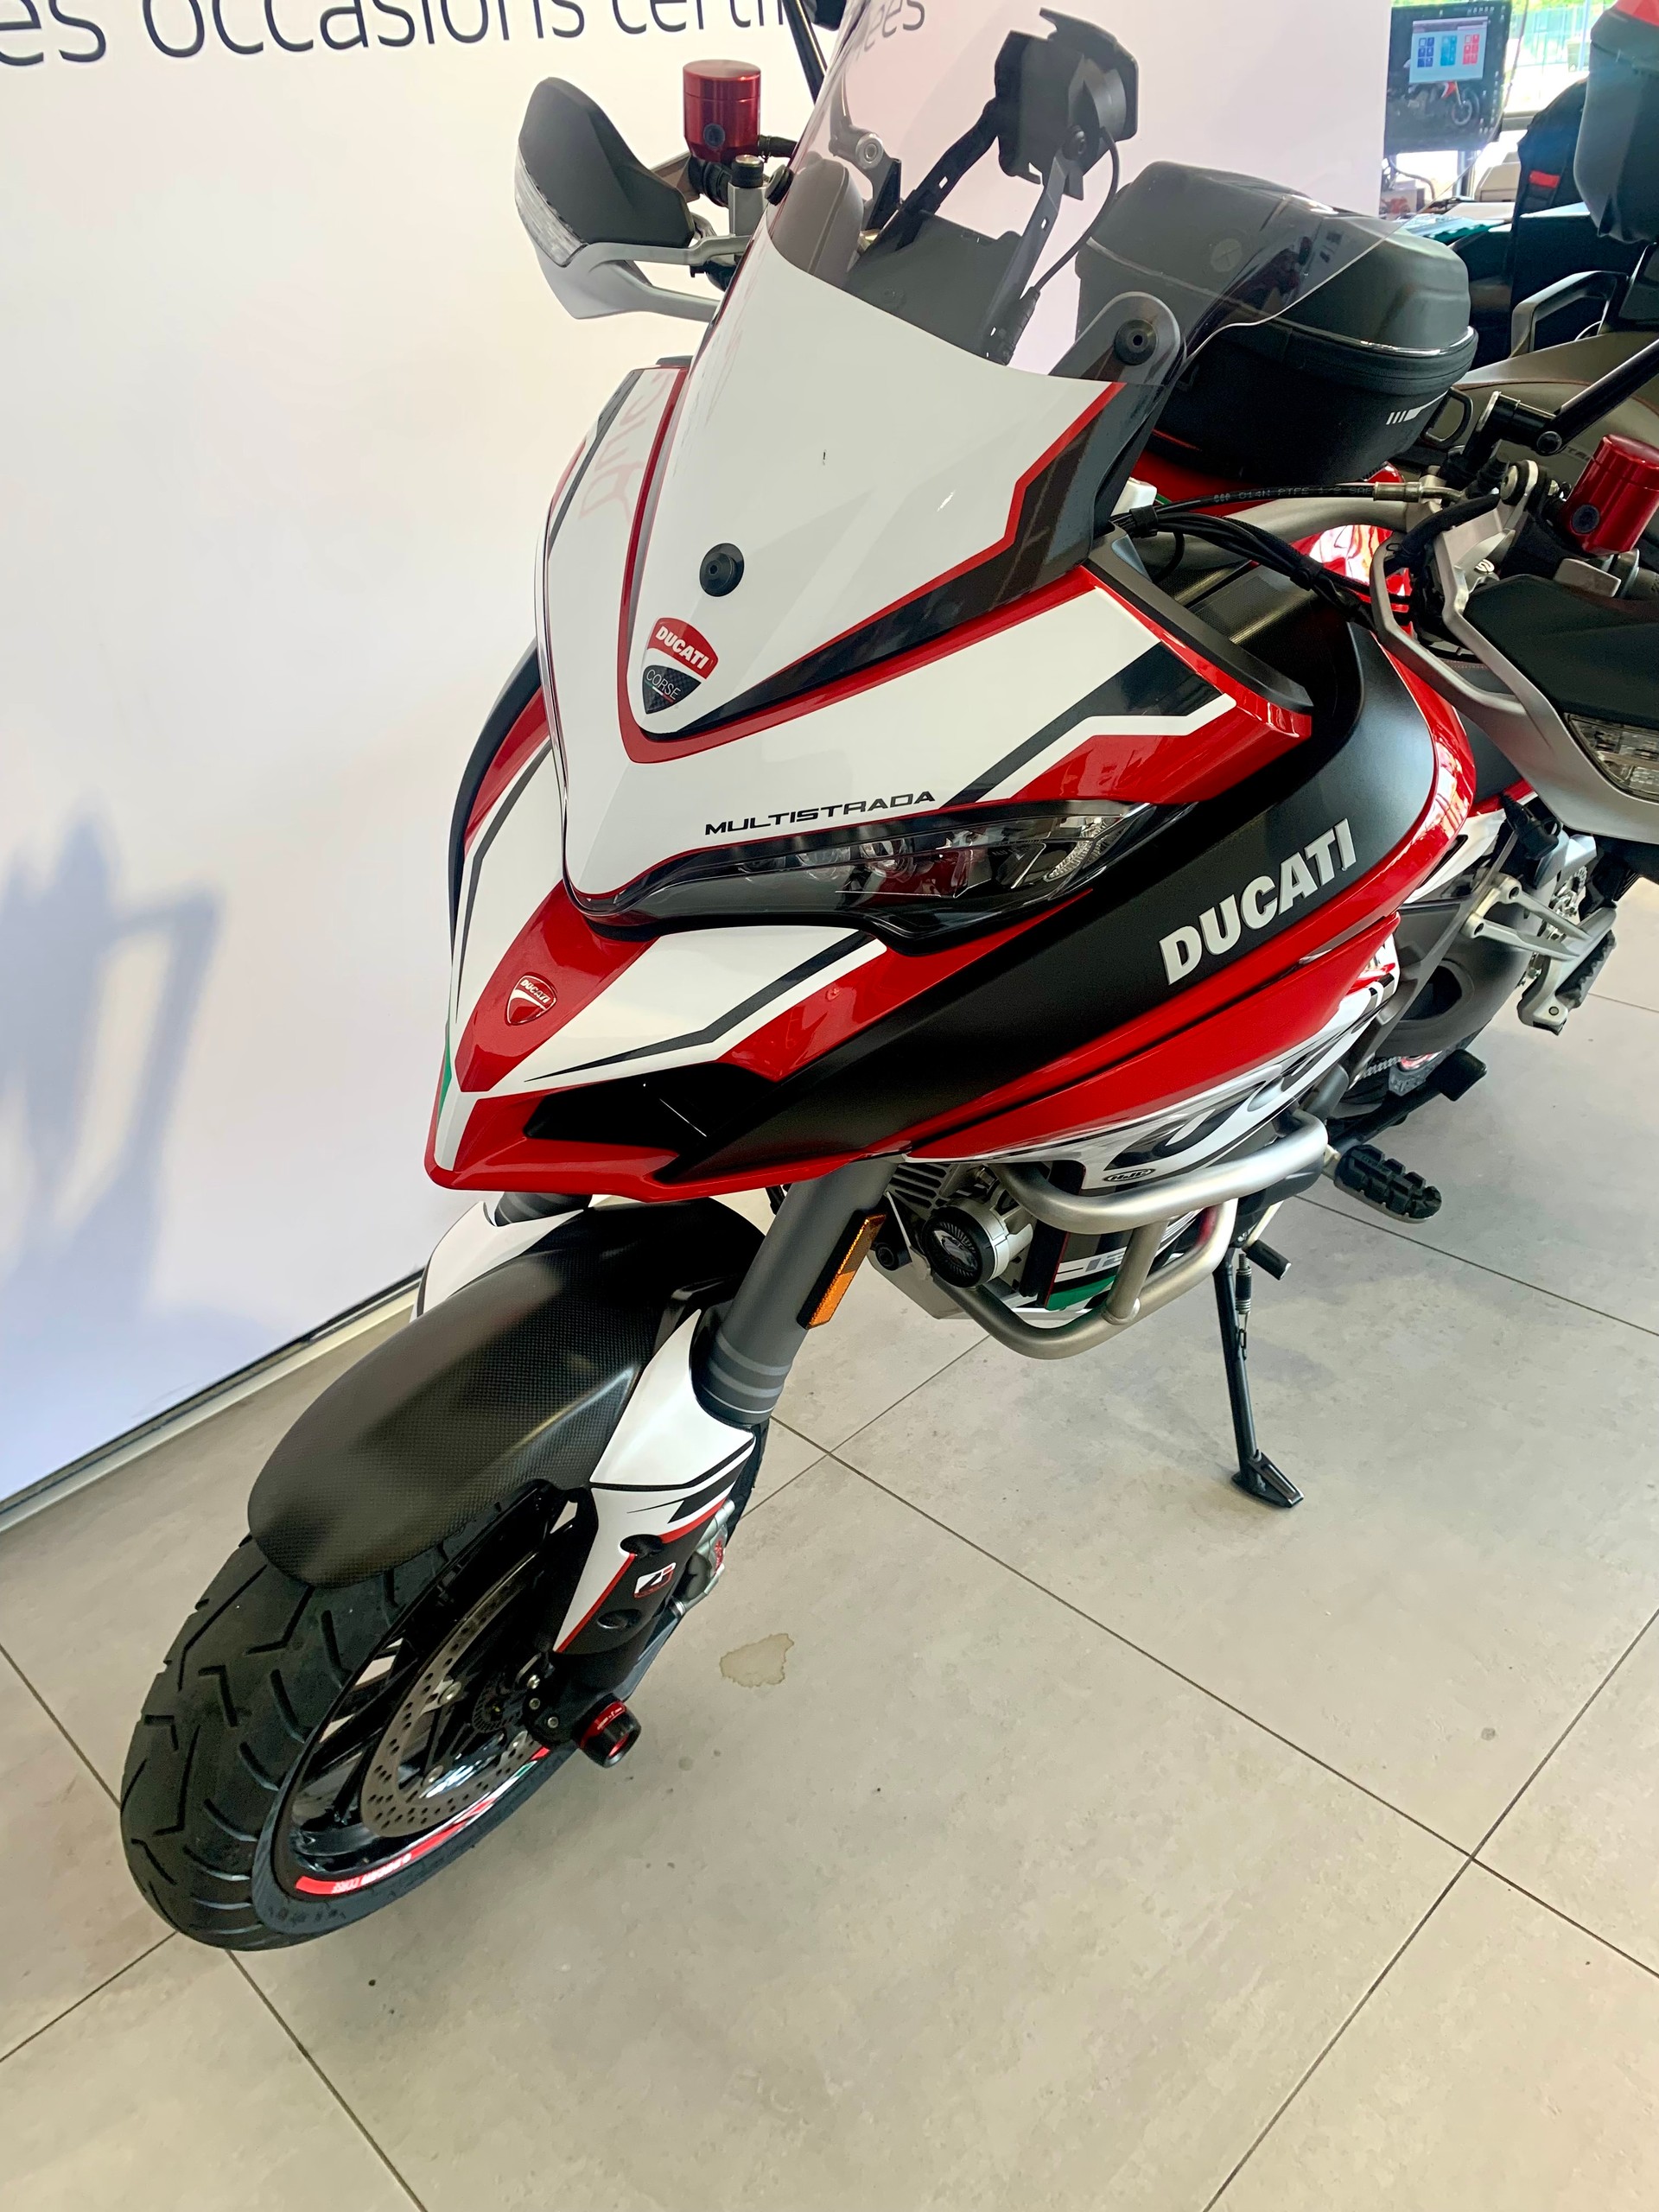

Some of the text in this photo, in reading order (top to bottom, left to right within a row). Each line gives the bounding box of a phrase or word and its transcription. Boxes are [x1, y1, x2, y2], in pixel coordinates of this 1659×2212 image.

[655, 626, 710, 670] DUCATI
[645, 669, 682, 700] CORSE
[705, 791, 936, 836] MULTISTRADA
[1158, 817, 1357, 986] DUCATI
[519, 979, 551, 1004] DUCATI
